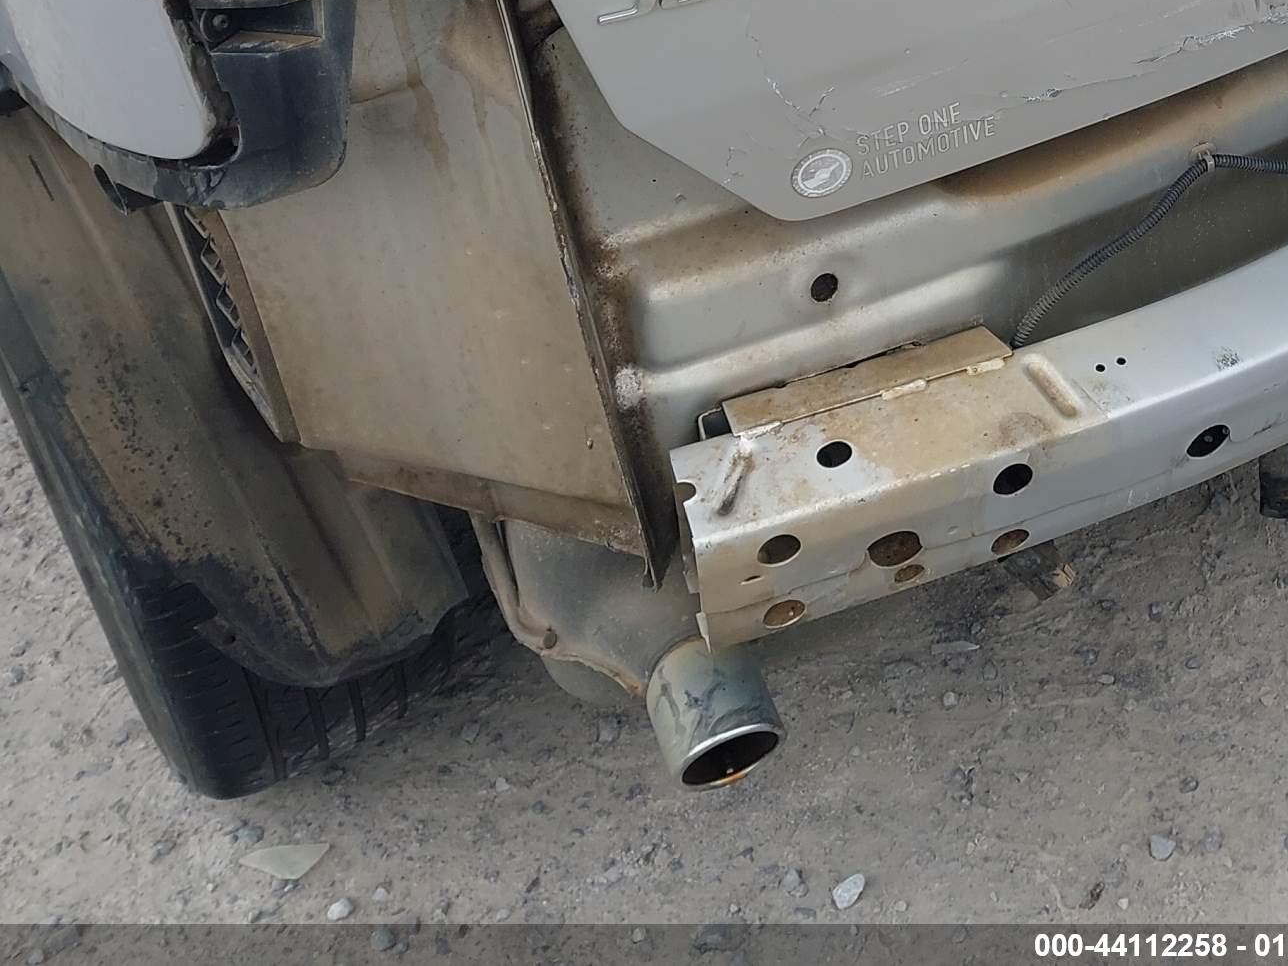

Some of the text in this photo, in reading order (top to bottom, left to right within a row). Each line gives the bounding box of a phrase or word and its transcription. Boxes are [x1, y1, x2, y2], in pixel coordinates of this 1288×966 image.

[856, 101, 961, 156] STEP ONE
[862, 115, 996, 180] AUTOMOTIVE
